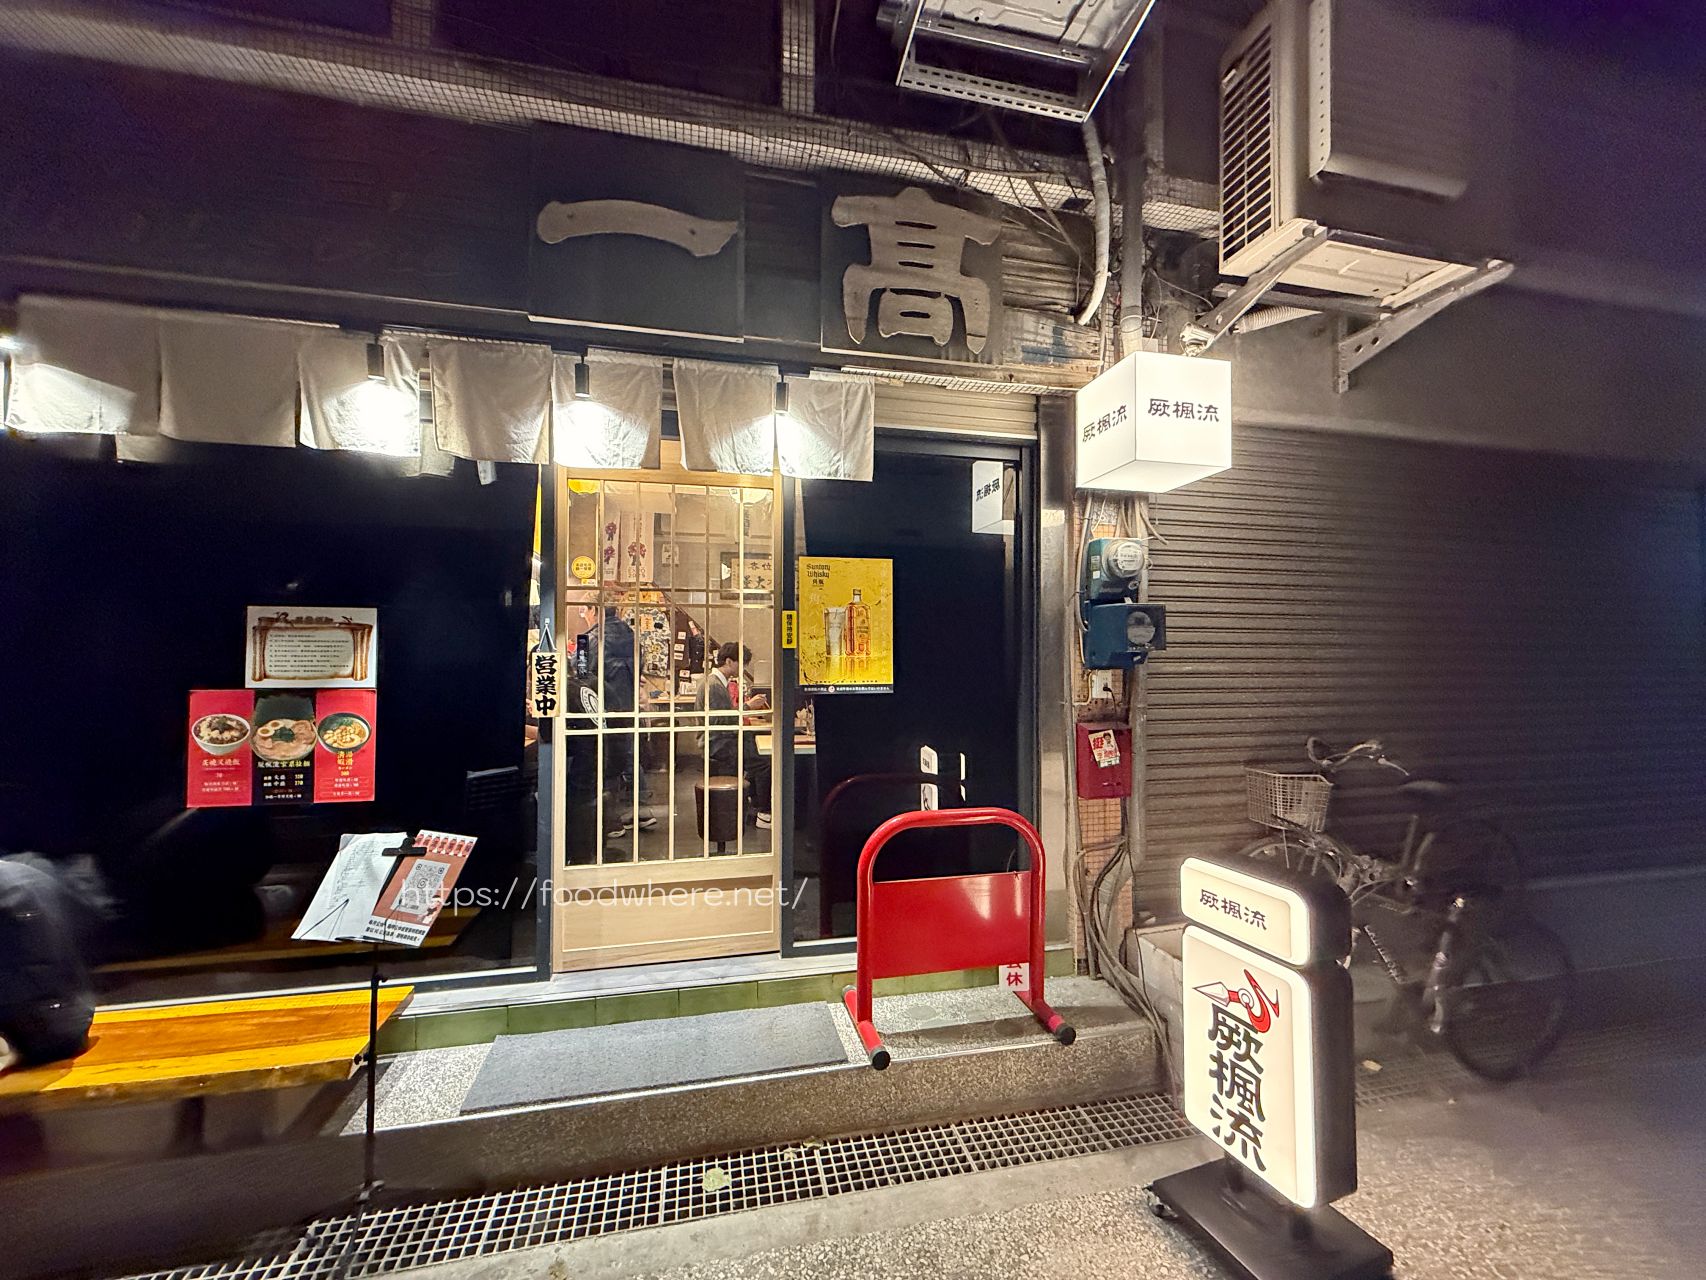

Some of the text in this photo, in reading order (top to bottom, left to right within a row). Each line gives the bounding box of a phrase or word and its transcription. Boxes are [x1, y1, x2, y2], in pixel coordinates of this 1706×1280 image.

[806, 563, 830, 571] Suntory
[807, 570, 829, 579] Whisky
[535, 655, 558, 716] 営業中
[1006, 963, 1024, 987] 休
